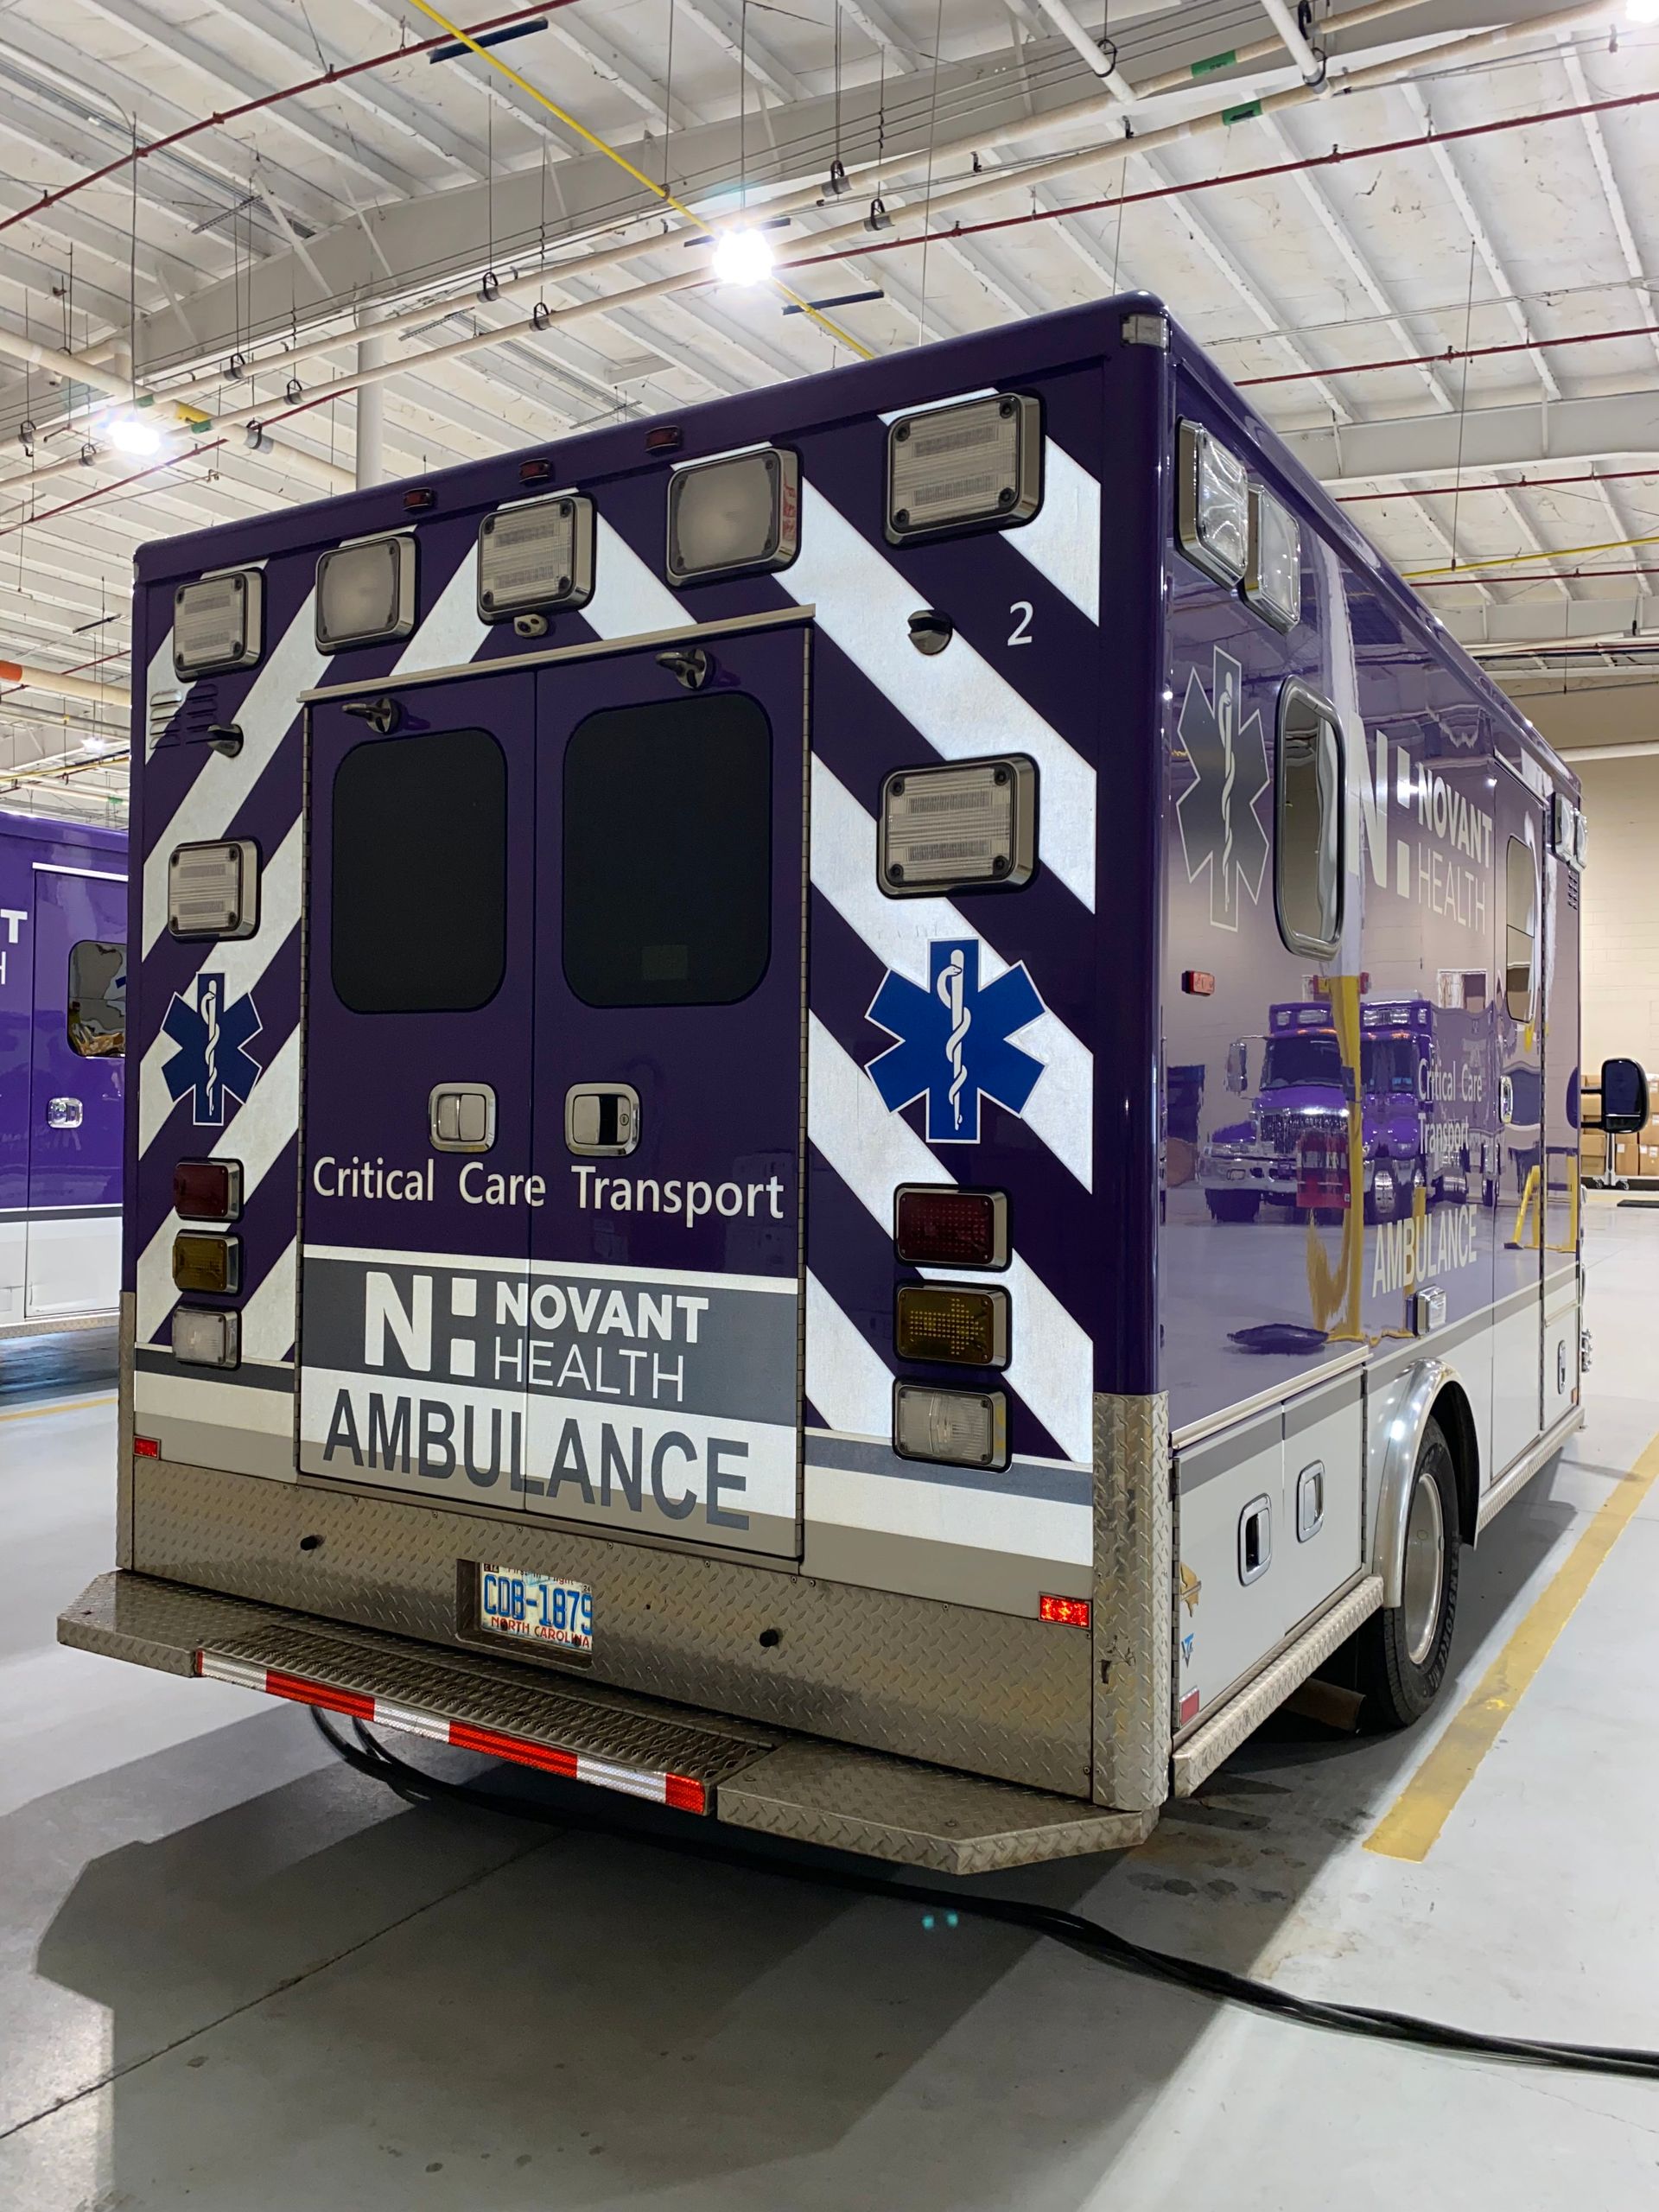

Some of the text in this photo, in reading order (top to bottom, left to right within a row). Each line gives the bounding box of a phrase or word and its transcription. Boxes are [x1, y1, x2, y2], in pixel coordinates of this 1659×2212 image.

[1007, 601, 1033, 645] 2
[1418, 761, 1492, 868] NOVANT
[1418, 842, 1485, 935] HEALTH
[1418, 1058, 1483, 1103] Critical Care
[1418, 1112, 1469, 1158] Transport
[313, 1157, 784, 1228] Critical Care Transport
[1372, 1204, 1478, 1298] AMBULANCE
[496, 1281, 709, 1344] NOVANT
[494, 1337, 683, 1402] HEALTH
[323, 1389, 749, 1530] AMBULANCE
[484, 1574, 594, 1636] CDB-1879
[492, 1617, 590, 1649] NORTH CAROLINA
